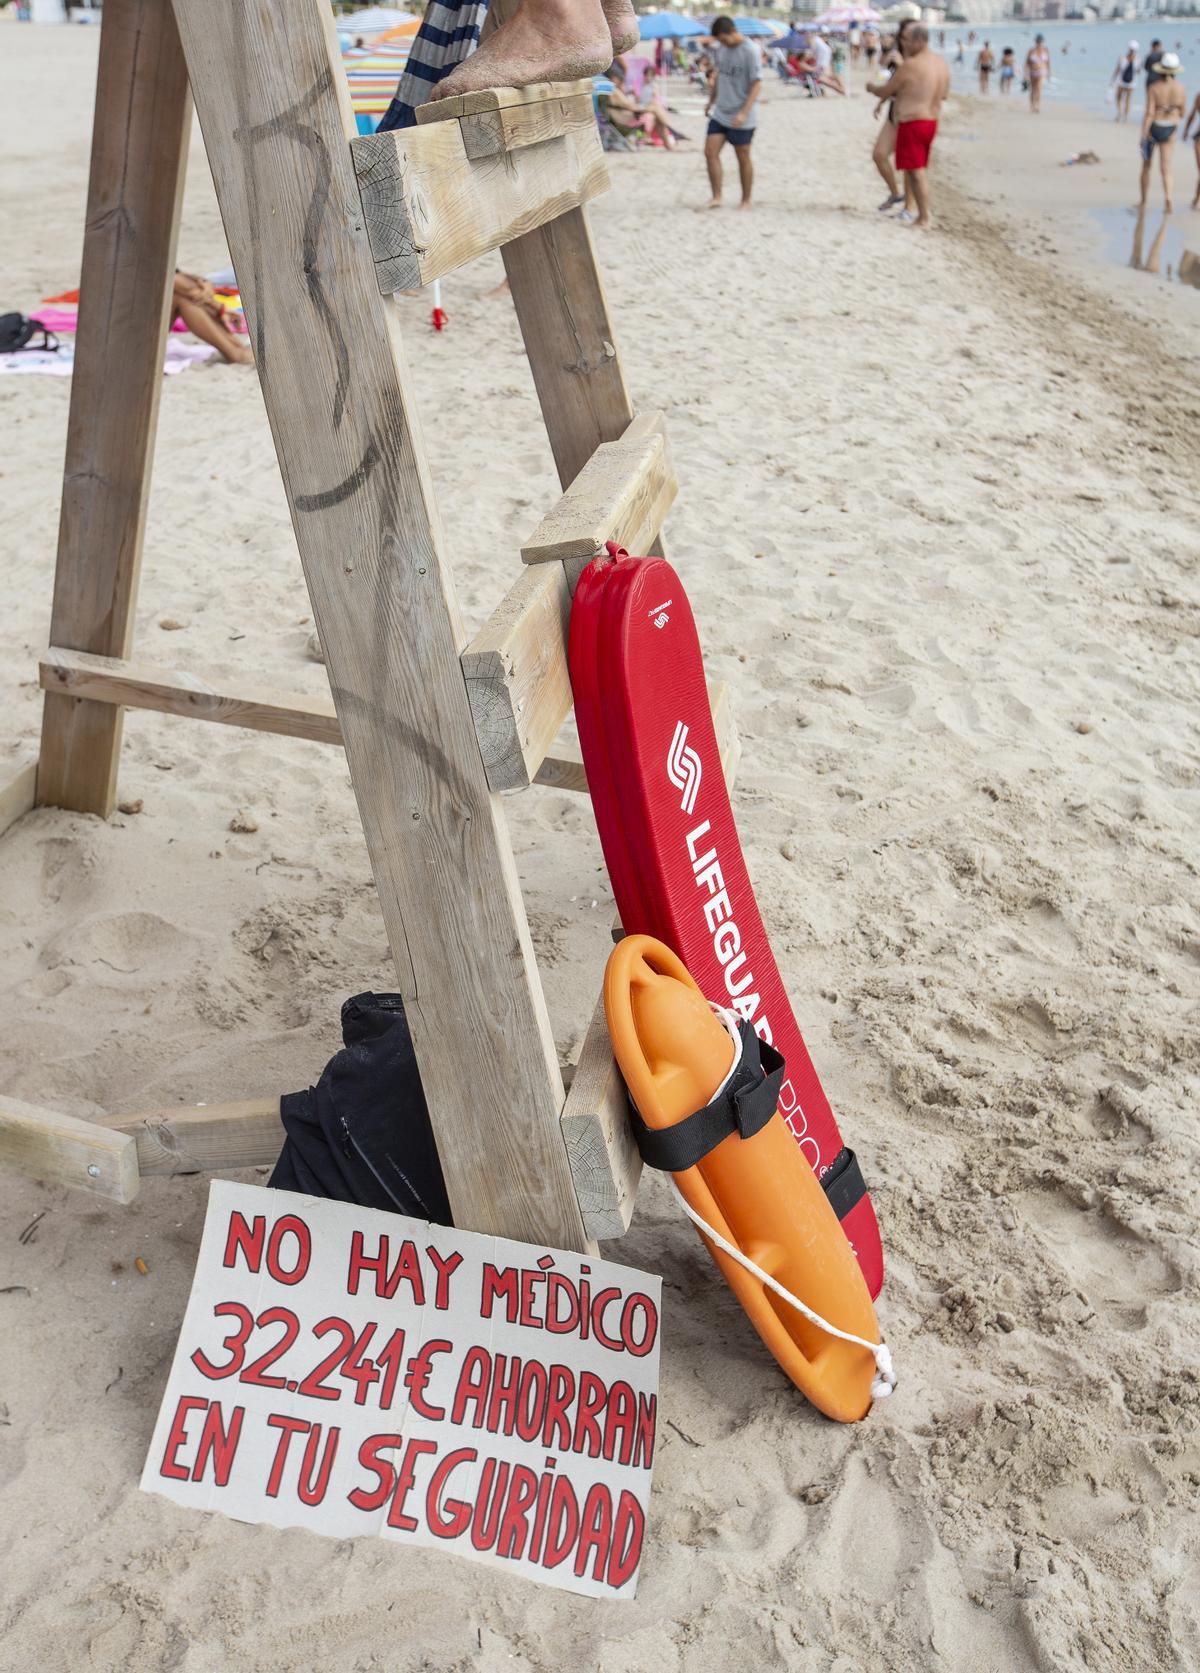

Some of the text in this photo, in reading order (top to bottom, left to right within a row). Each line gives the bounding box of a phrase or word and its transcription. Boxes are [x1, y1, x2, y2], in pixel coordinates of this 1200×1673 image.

[223, 1211, 312, 1285] NO
[347, 1230, 464, 1310] HAY
[160, 1395, 245, 1487] EN
[266, 1413, 341, 1506] TU
[451, 1345, 657, 1469] AHORRAN
